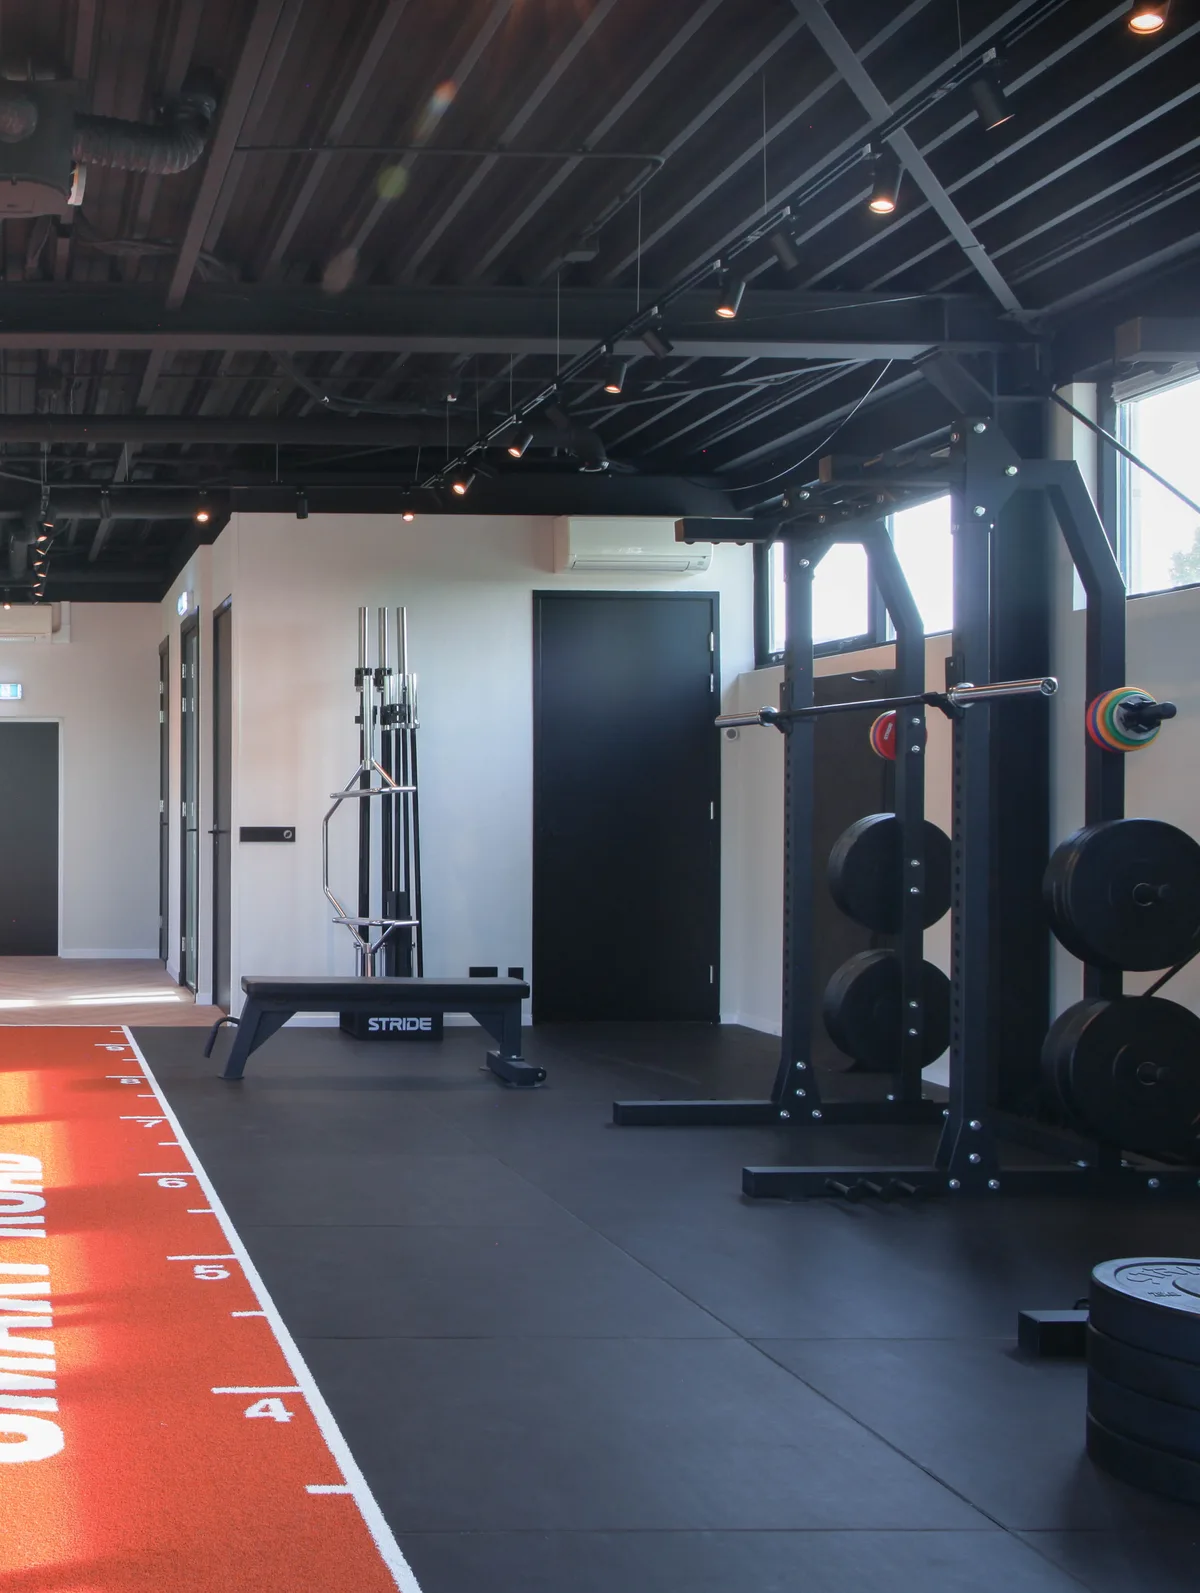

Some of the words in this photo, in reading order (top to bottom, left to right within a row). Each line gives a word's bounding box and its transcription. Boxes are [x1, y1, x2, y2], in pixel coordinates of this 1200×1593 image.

[368, 1017, 432, 1031] STRIDE
[136, 1119, 163, 1128] 7
[157, 1177, 188, 1189] 6
[193, 1264, 231, 1280] 5
[243, 1397, 295, 1422] 4
